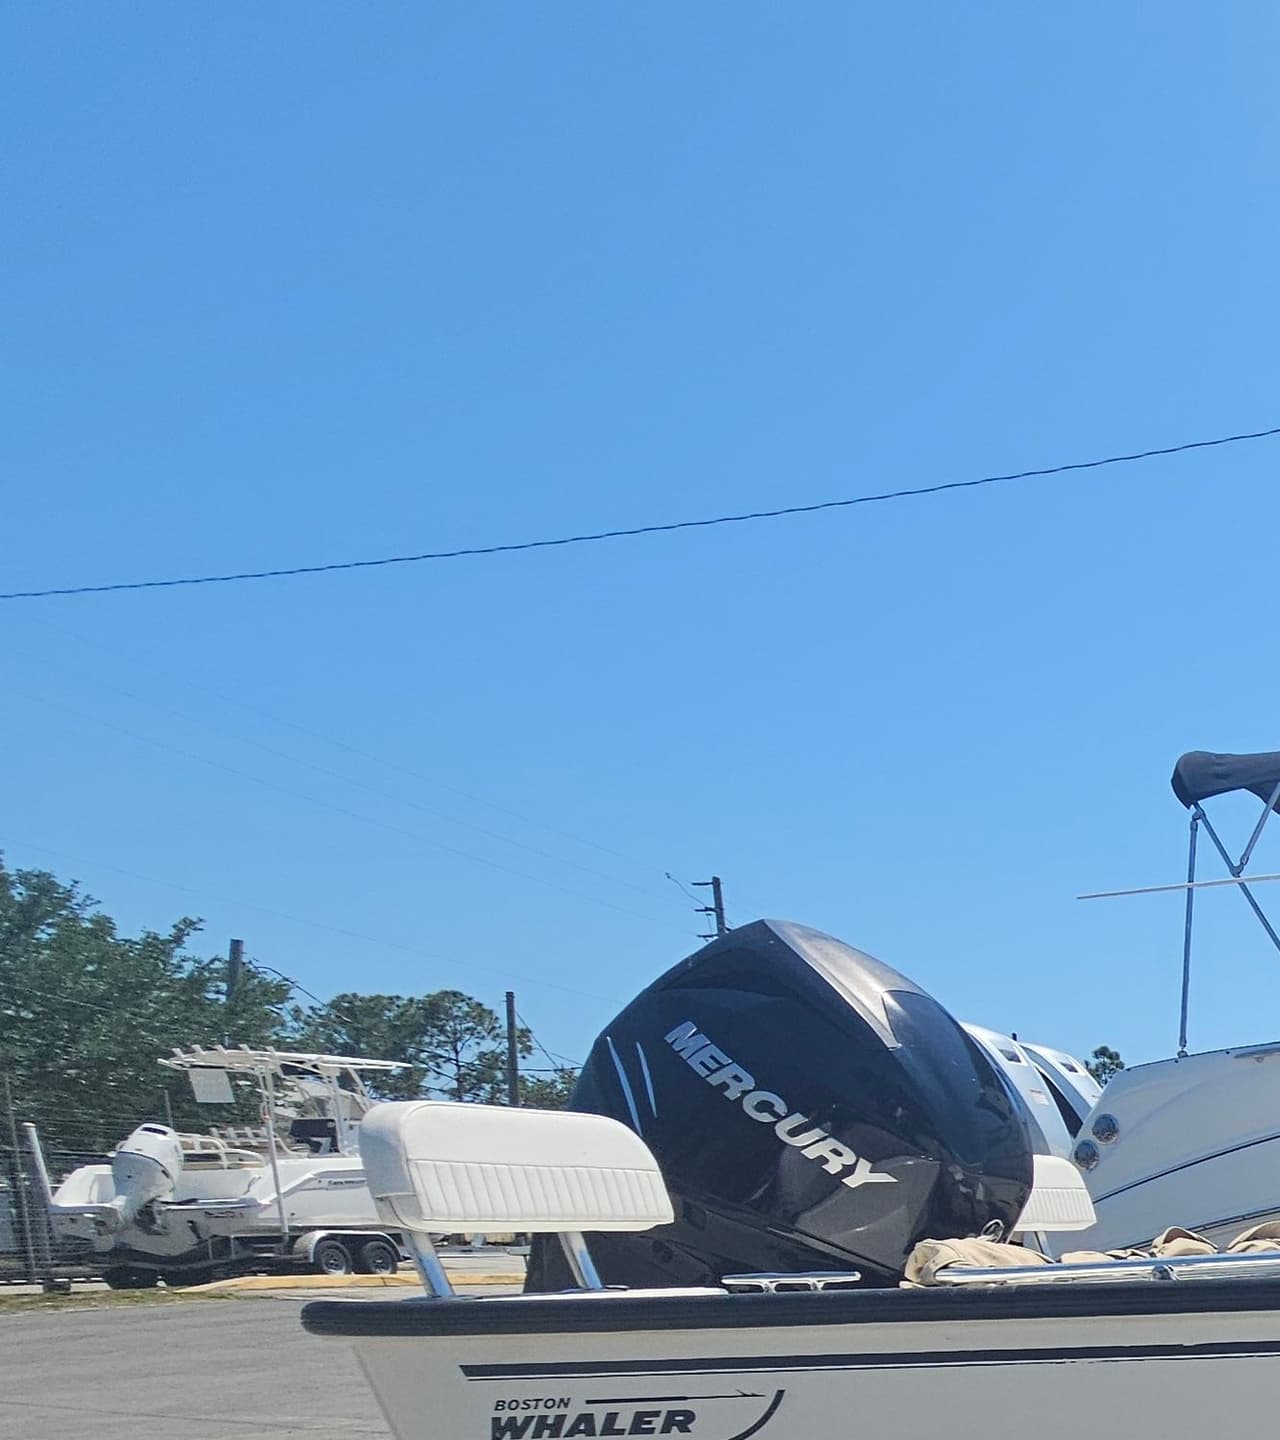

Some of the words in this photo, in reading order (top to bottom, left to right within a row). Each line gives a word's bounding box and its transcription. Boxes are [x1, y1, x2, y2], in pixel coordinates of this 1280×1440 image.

[664, 1020, 899, 1188] MERCURY
[494, 1398, 571, 1412] BOSTON
[491, 1409, 696, 1440] WHALER
